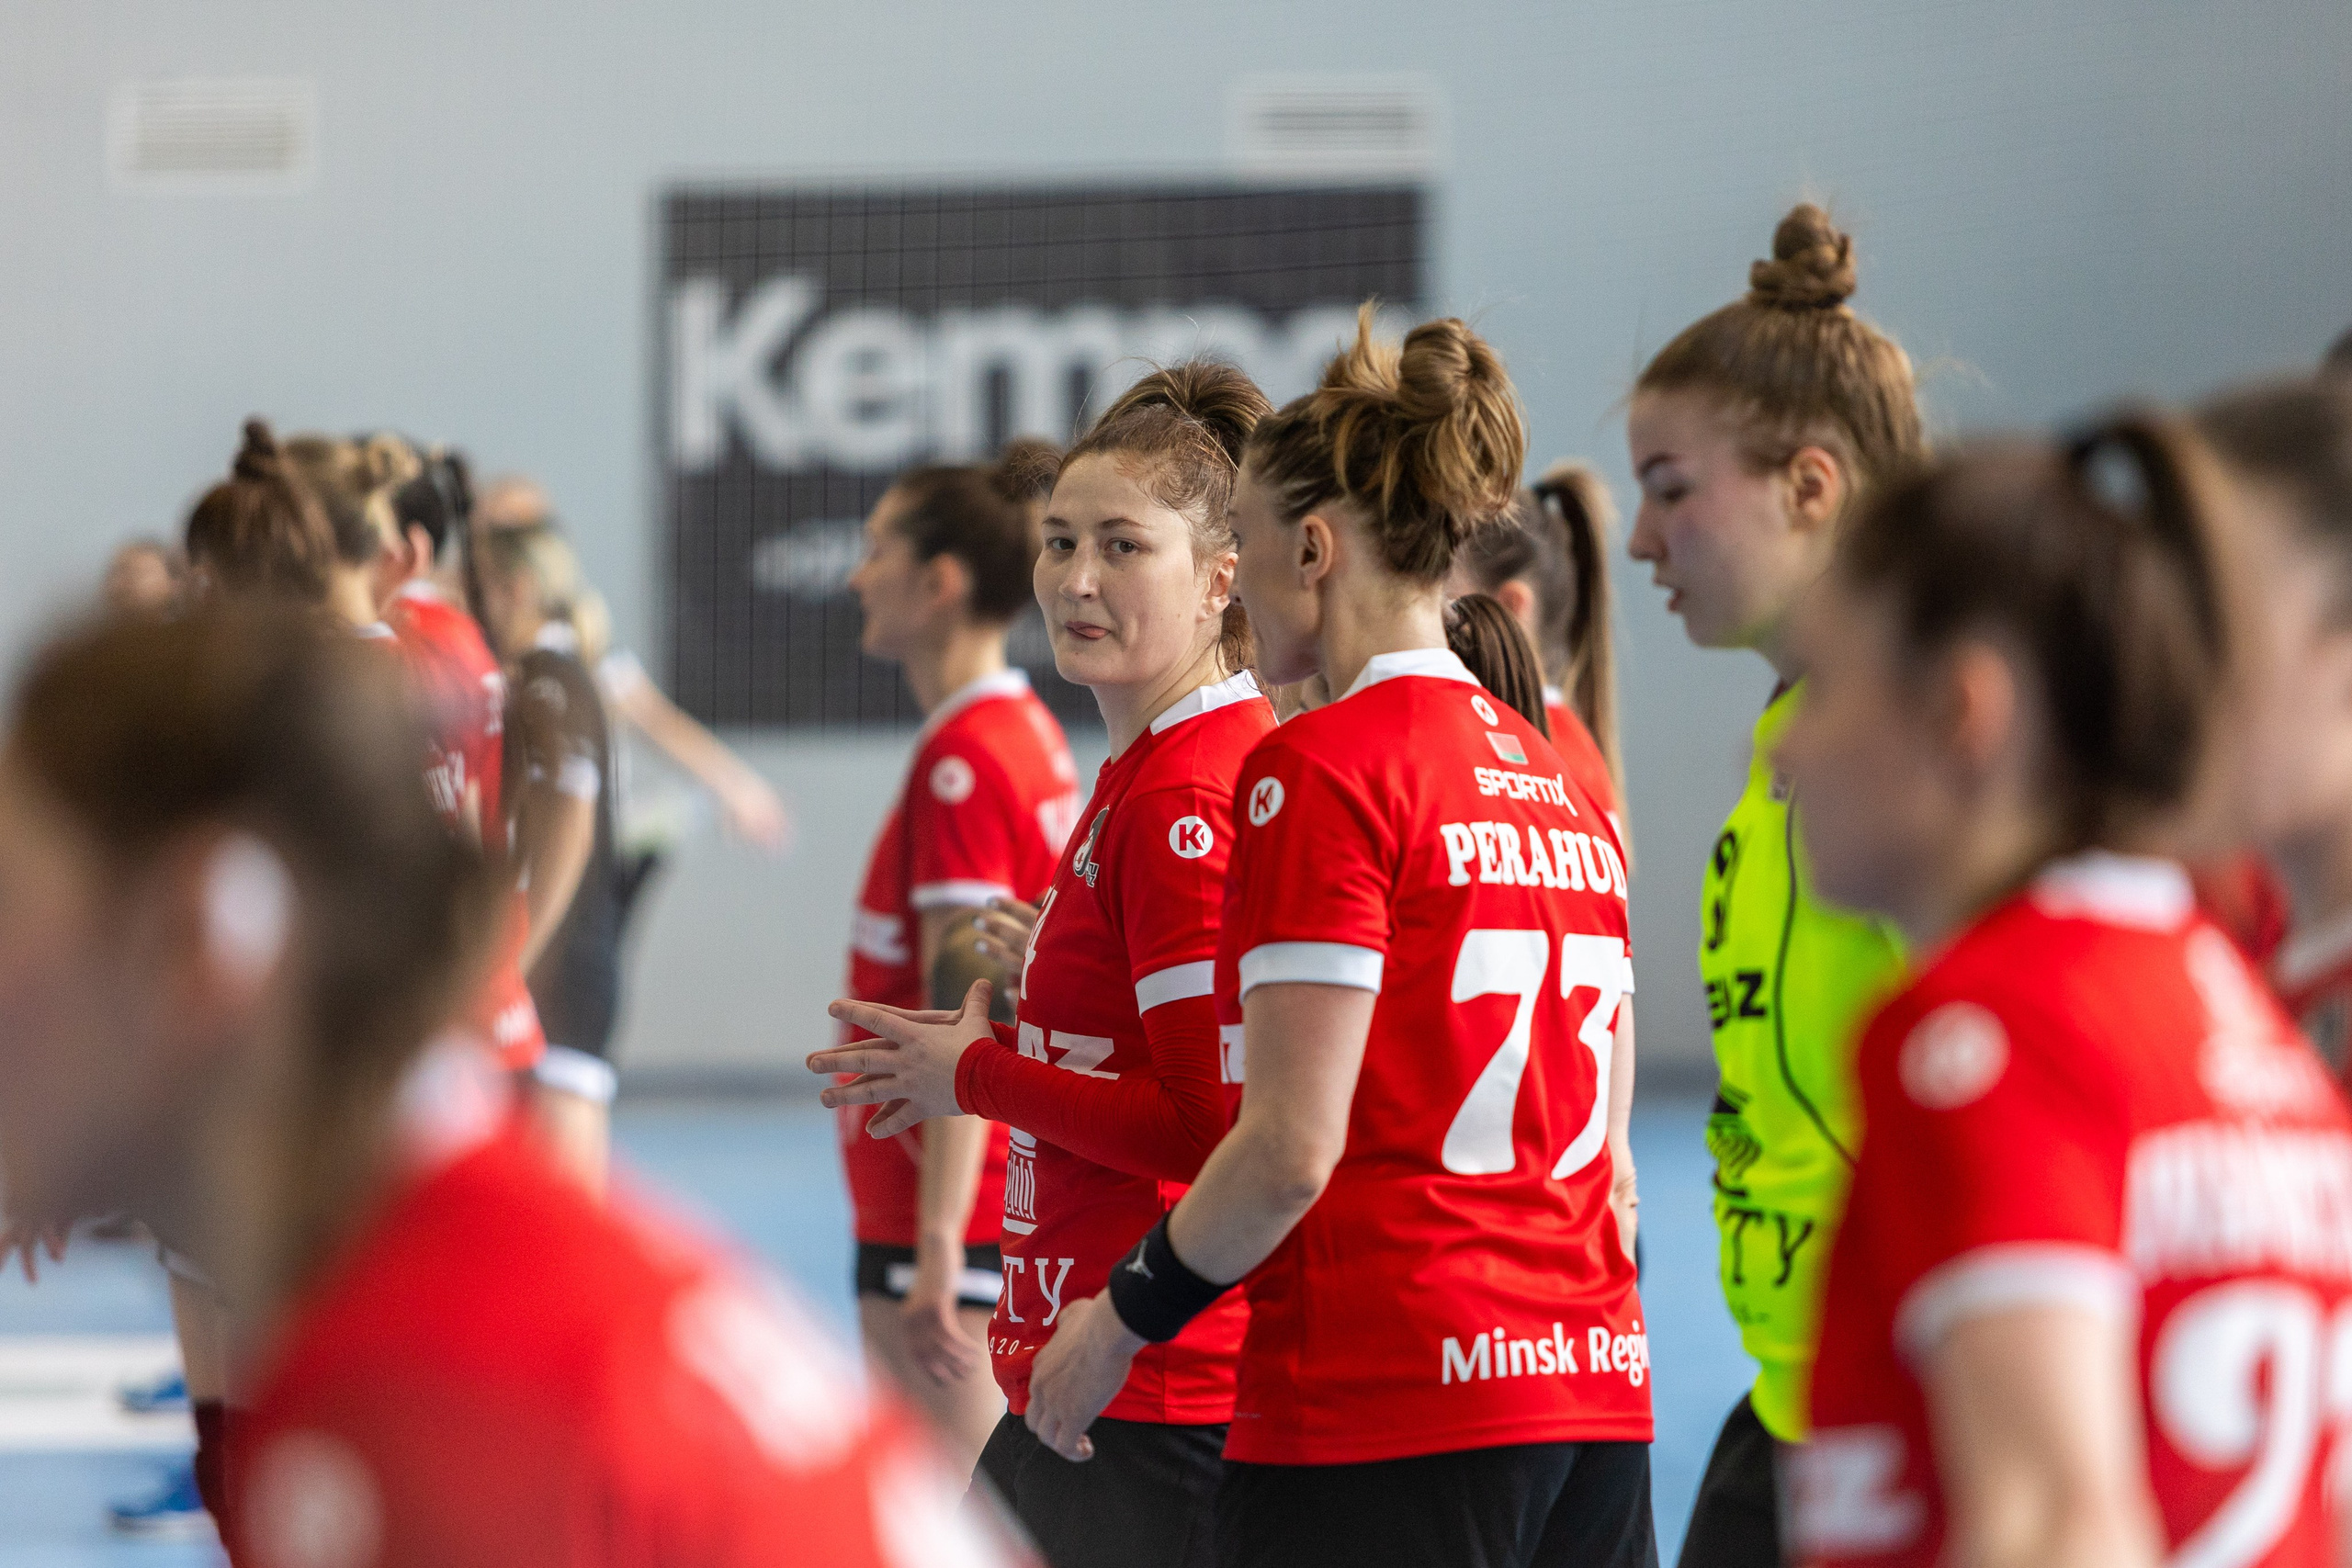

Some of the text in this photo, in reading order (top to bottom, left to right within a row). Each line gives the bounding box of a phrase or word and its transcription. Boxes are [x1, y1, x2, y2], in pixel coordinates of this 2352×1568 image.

[1474, 766, 1578, 817] SPORTIX
[1442, 928, 1625, 1180] 73
[993, 1255, 1075, 1326] TY
[1442, 1321, 1579, 1385] Minsk
